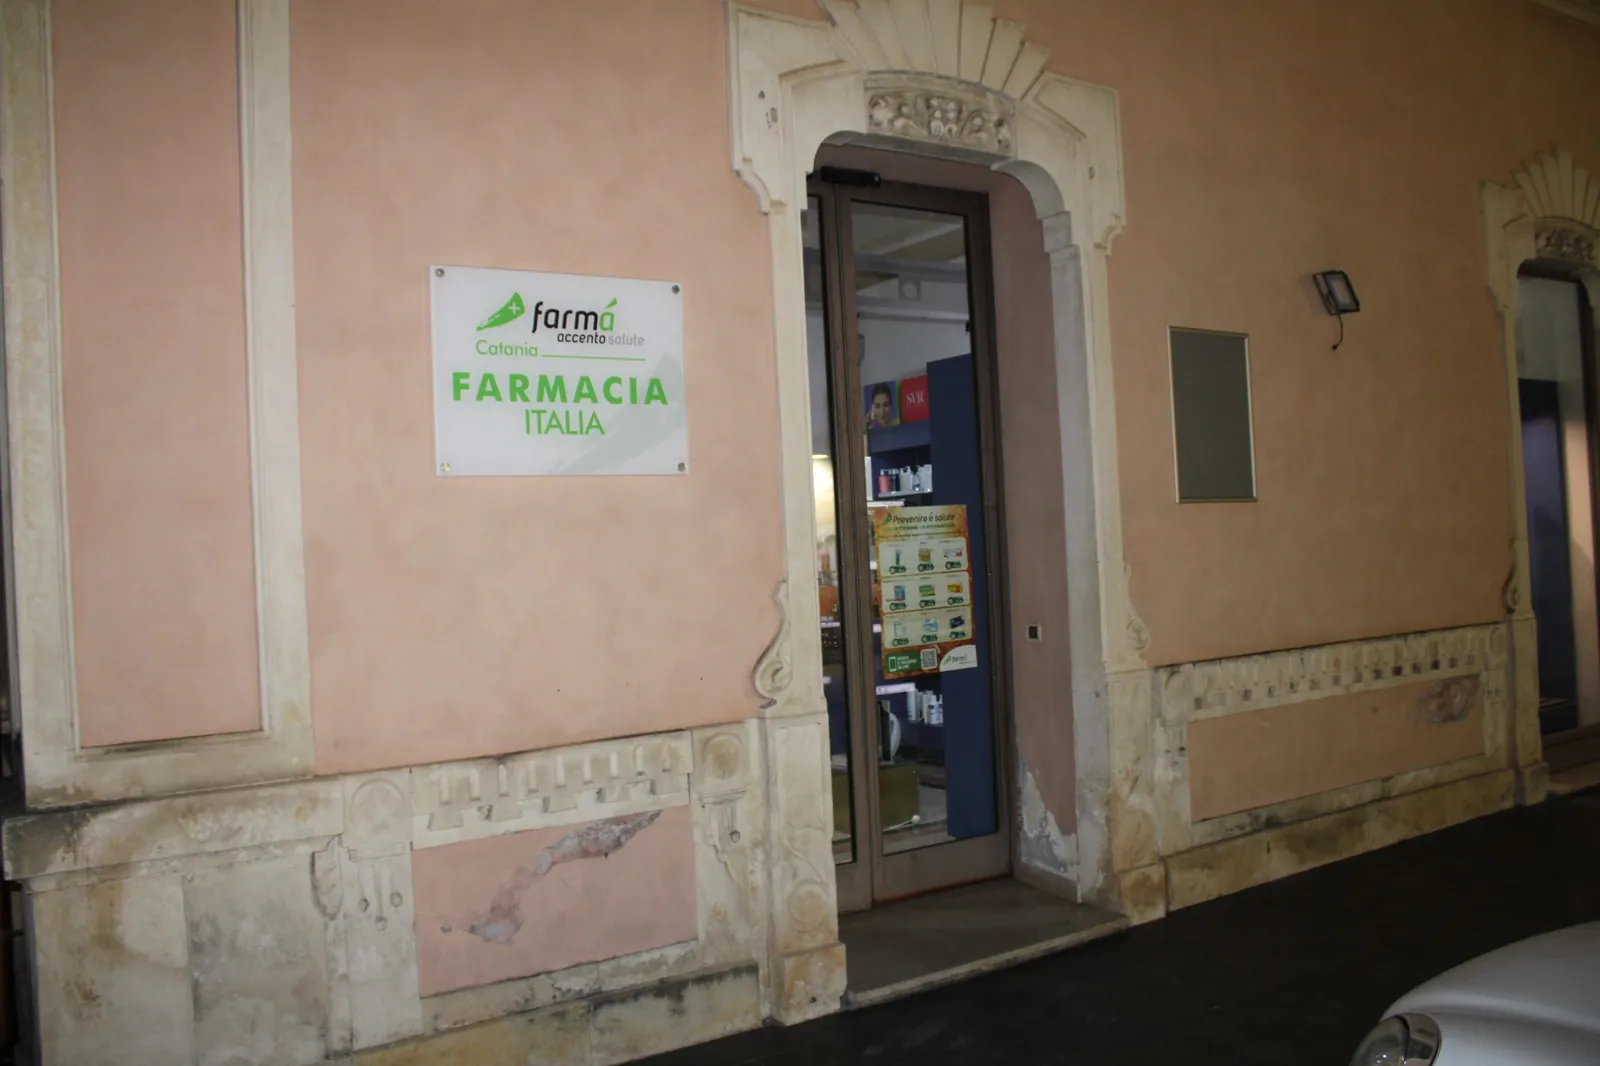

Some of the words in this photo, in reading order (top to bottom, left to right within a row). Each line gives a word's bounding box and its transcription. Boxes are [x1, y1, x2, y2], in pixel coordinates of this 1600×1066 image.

[532, 297, 618, 333] farmá
[475, 339, 538, 357] Catania
[557, 331, 606, 344] accento
[608, 333, 645, 346] salute
[452, 371, 668, 405] FARMACIA
[525, 409, 605, 435] ITALIA
[893, 514, 927, 524] Prevenire
